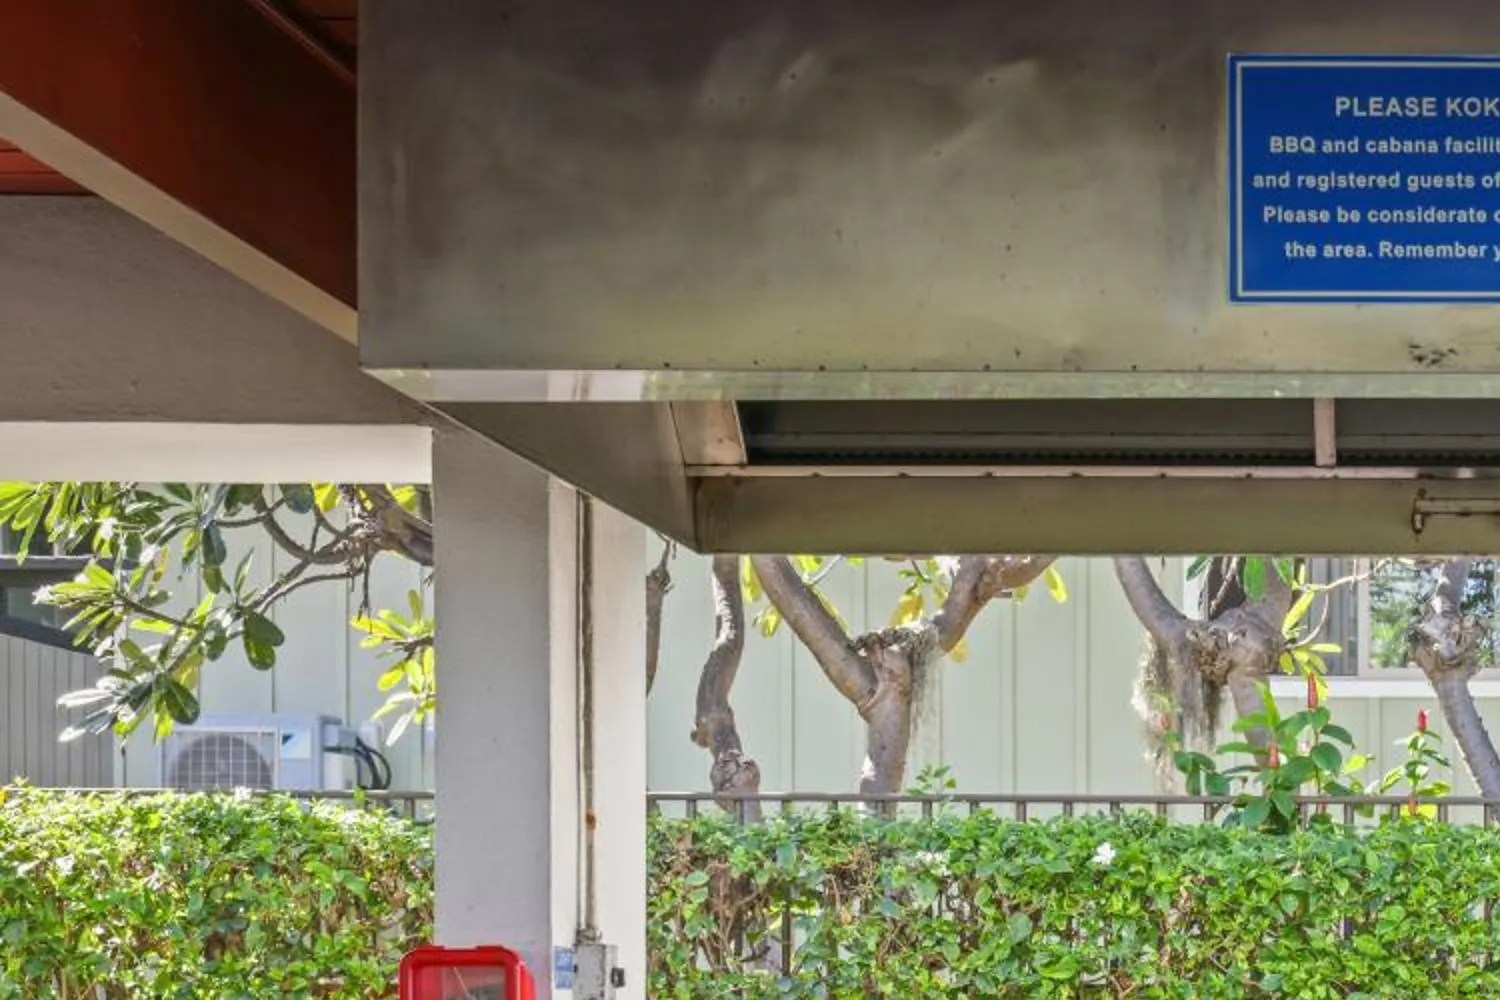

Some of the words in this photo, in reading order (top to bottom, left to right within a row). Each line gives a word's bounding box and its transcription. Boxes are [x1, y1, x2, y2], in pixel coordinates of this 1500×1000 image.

[1335, 96, 1437, 117] PLEASE
[1269, 135, 1316, 154] BBQ
[1321, 136, 1359, 154] and
[1365, 136, 1439, 154] cabana
[1253, 171, 1291, 189] and
[1297, 171, 1401, 193] registered
[1407, 172, 1476, 193] guests
[1263, 205, 1331, 223] Please
[1337, 206, 1361, 223] be
[1367, 206, 1487, 223] considerate
[1284, 241, 1317, 258] the
[1323, 244, 1373, 258] area.
[1378, 240, 1488, 259] Remember
